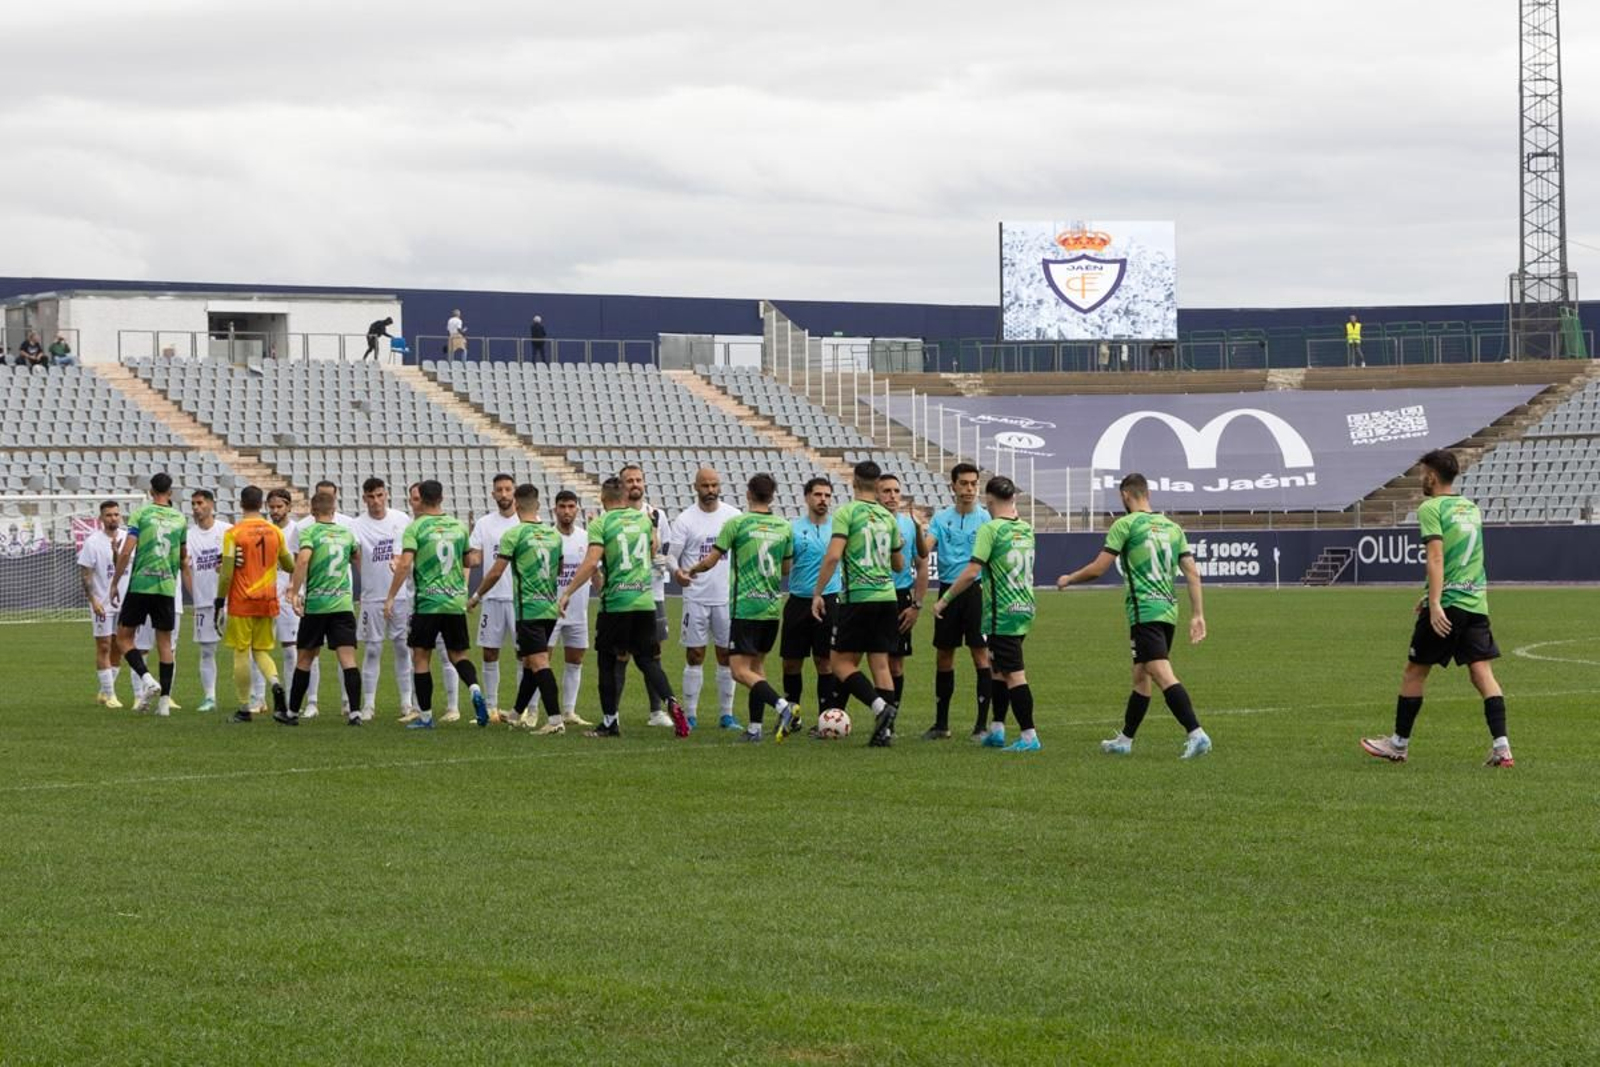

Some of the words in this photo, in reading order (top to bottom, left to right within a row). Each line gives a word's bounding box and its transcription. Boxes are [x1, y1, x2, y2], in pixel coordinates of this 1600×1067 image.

[1202, 472, 1318, 492] Jaén!
[156, 525, 171, 558] 5
[255, 536, 266, 568] 1
[436, 540, 455, 576] 9
[616, 533, 650, 571] 14
[1210, 542, 1259, 558] 100%
[1460, 523, 1478, 566] 7
[328, 545, 344, 577] 2
[758, 541, 776, 577] 6
